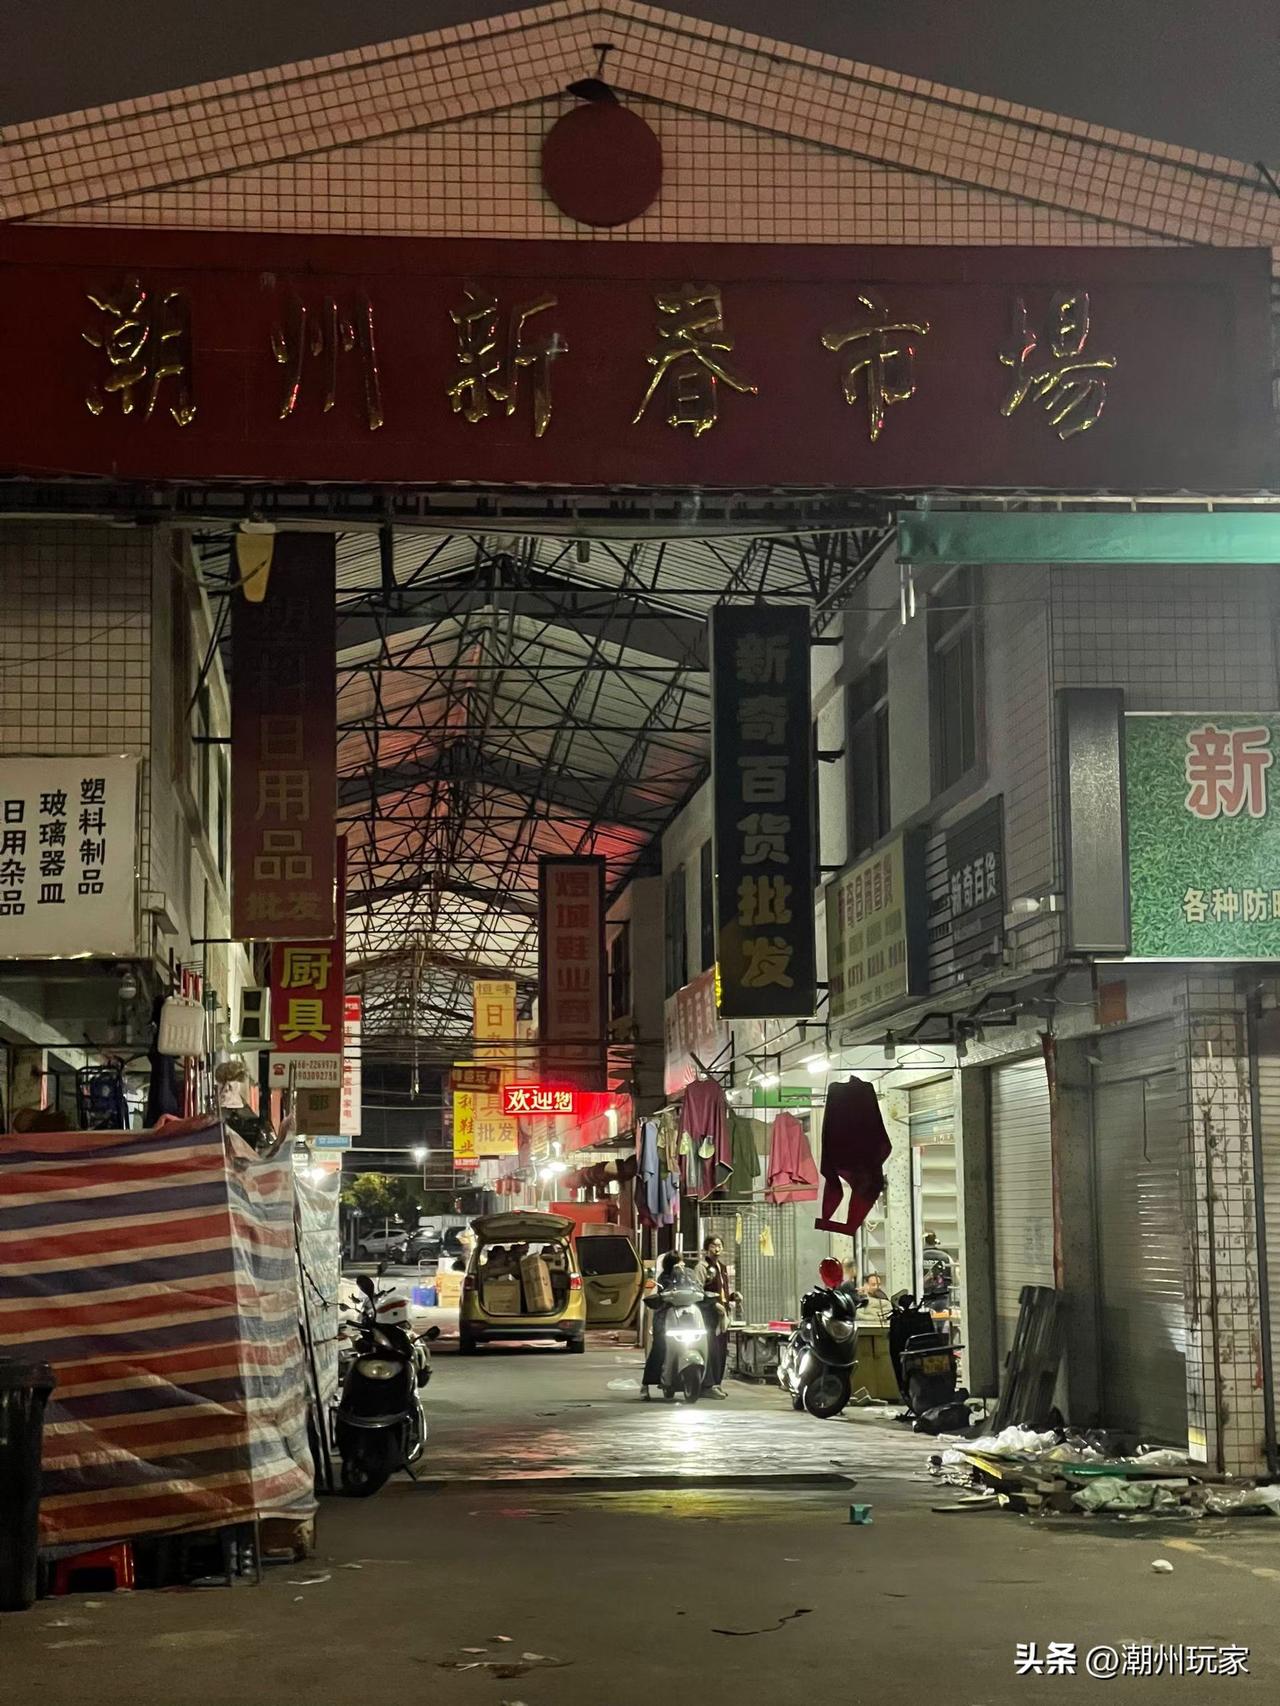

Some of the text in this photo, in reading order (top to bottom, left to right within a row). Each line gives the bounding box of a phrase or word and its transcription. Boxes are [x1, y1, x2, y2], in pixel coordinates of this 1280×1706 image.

[735, 633, 795, 988] 新奇百货批发
[1185, 724, 1273, 819] 新
[0, 800, 26, 916] 日用杂品
[37, 789, 67, 904] 玻璃器皿
[78, 778, 107, 895] 塑料制品
[950, 851, 997, 915] 新奇百货
[245, 892, 323, 920] 批发
[279, 947, 332, 1041] 厨具
[480, 1004, 508, 1117] 日杂具
[507, 1089, 571, 1111] 欢迎您
[457, 1093, 474, 1153] 利鞋业
[478, 1123, 514, 1142] 批发
